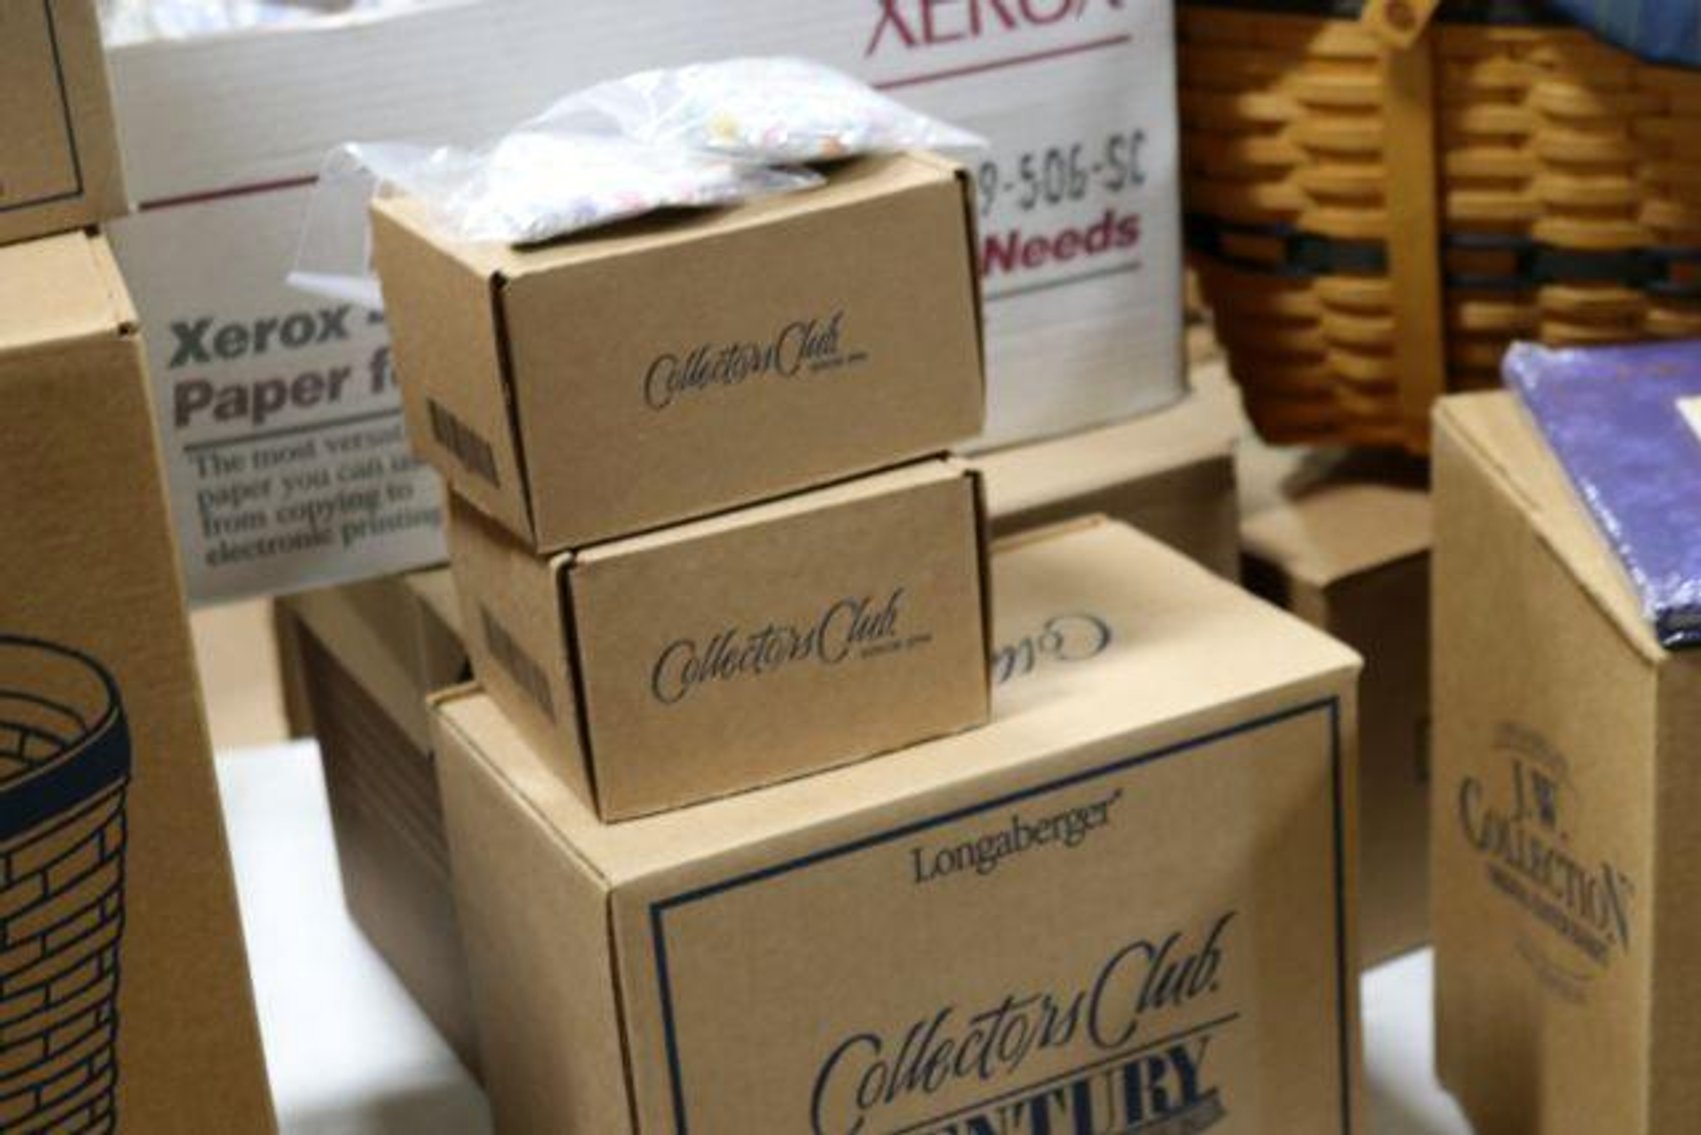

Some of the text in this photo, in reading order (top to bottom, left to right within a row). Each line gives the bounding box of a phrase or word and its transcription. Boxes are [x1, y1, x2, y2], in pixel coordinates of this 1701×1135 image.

[979, 208, 1141, 277] Needs
[168, 305, 351, 370] Xerox
[173, 365, 351, 428] Paper
[197, 450, 246, 478] The
[197, 477, 271, 513] paper
[280, 467, 331, 498] you
[336, 455, 385, 482] can
[203, 510, 267, 537] from
[386, 481, 415, 502] to
[651, 620, 814, 703] Collectors
[811, 992, 1086, 1135] Collectors
